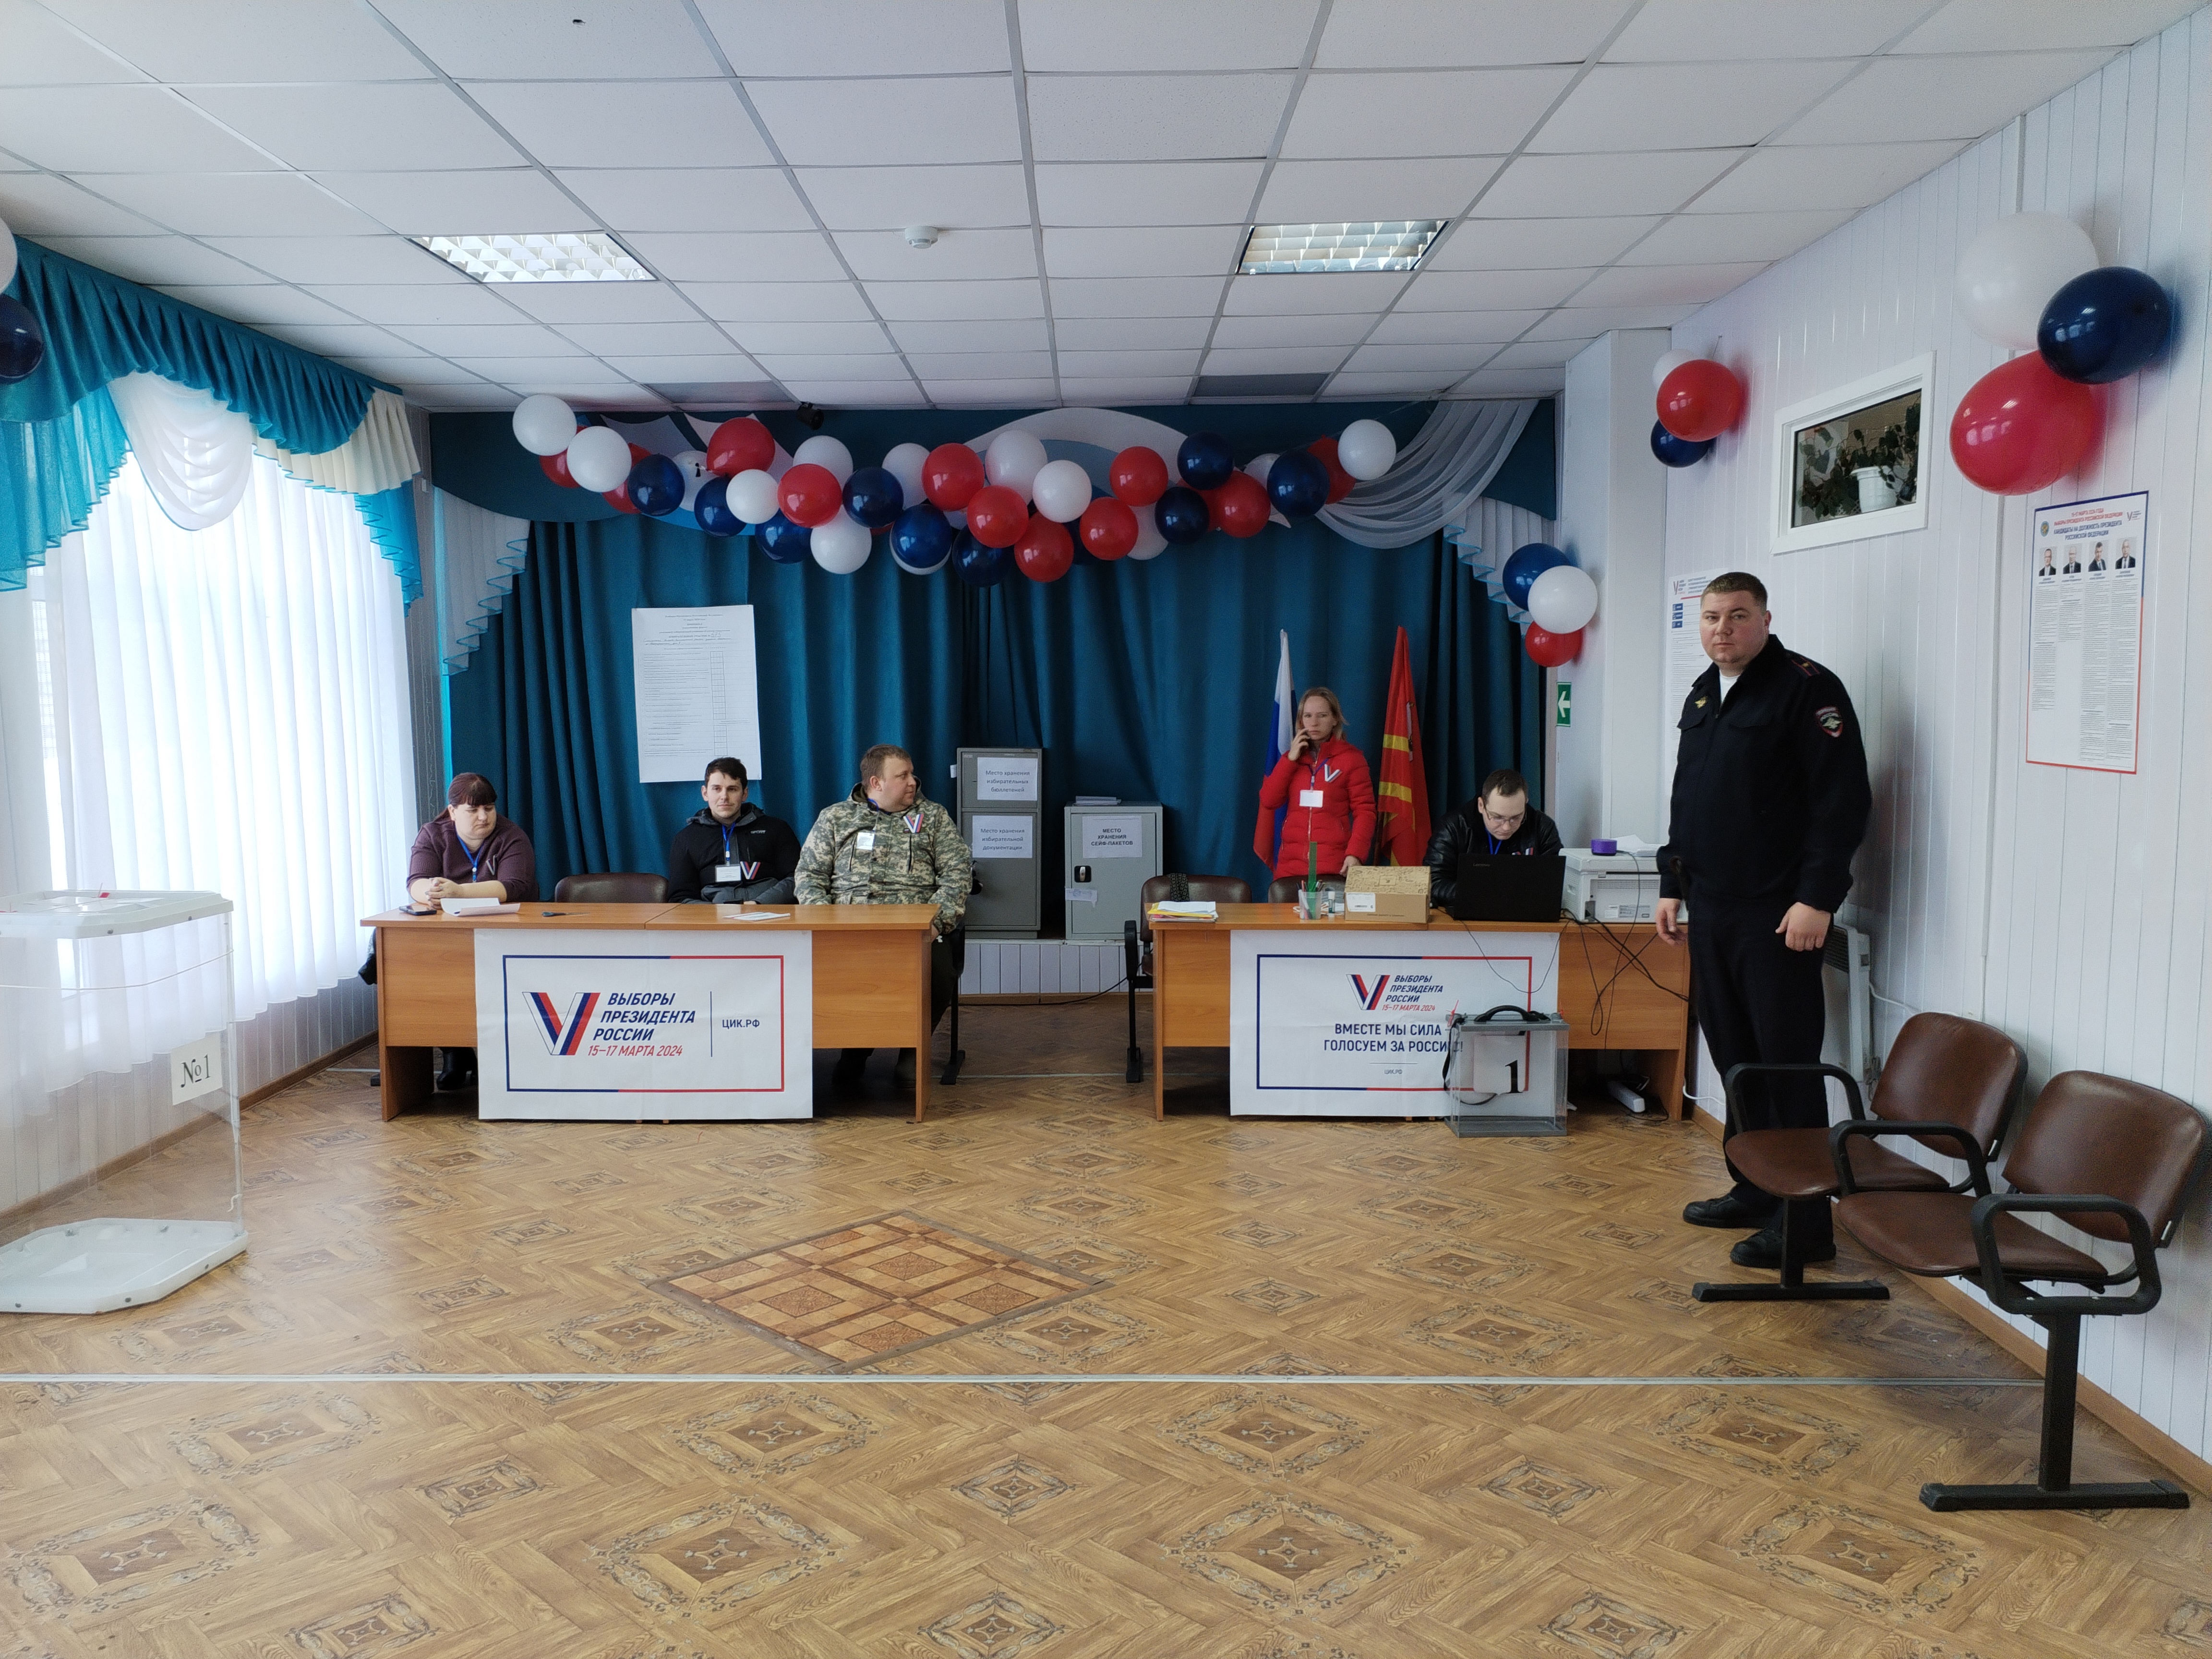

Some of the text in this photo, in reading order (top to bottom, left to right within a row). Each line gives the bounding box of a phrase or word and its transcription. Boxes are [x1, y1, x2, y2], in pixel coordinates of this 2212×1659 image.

[1389, 985, 1443, 994] ПРЕЗИДЕНТА
[607, 993, 676, 1006] ВЫБОРЫ
[600, 1010, 696, 1025] ПРЕЗИДЕНТА
[722, 1019, 760, 1030] ЦИК.РФ
[1334, 1023, 1382, 1035] ВМЕСТЕ
[1385, 1024, 1407, 1035] МЫ
[1410, 1024, 1442, 1035] СИЛА
[592, 1028, 655, 1041] РОССИИ
[618, 1045, 654, 1056] МАРТА
[656, 1045, 684, 1057] 2024
[1323, 1039, 1387, 1052] ГОЛОСУЕМ
[1390, 1040, 1405, 1052] ЗА
[1504, 1059, 1524, 1094] 1
